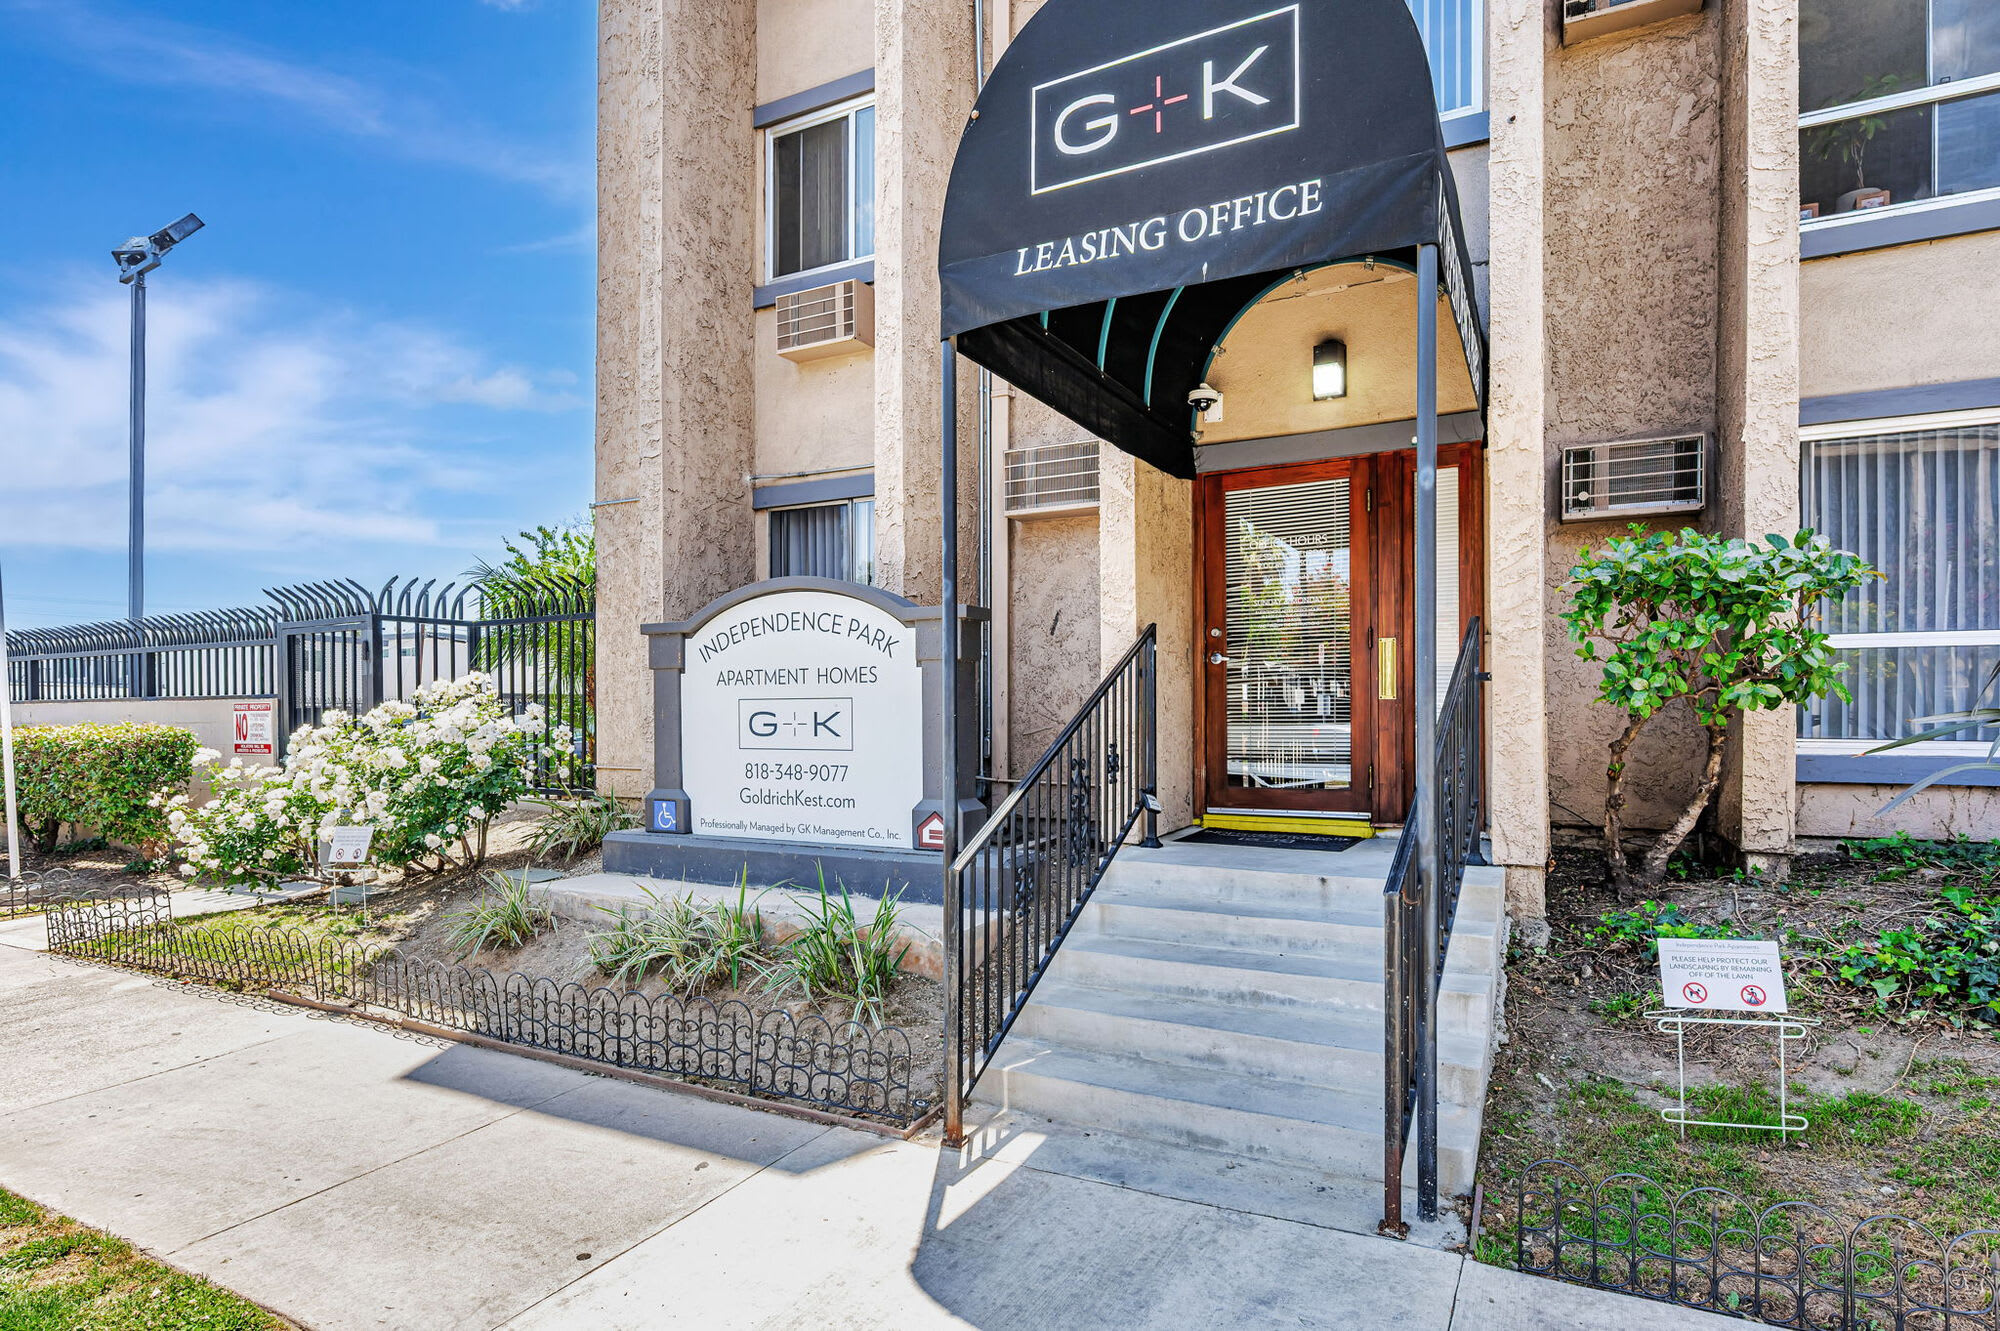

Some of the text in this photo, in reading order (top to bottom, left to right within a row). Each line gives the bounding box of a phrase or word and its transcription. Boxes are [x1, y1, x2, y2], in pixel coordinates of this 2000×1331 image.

[1013, 178, 1324, 276] LEASING OFFICE
[698, 611, 900, 663] INDEPENDENCE PARK
[716, 665, 878, 686] APARTMENT HOMES
[249, 703, 270, 711] PROPERTY
[235, 713, 248, 741] NO
[744, 763, 849, 782] 818-348-9077
[739, 787, 856, 808] GoldrichKest.com
[700, 817, 748, 832] Professionally
[749, 821, 785, 835] Managed
[786, 823, 796, 836] by
[797, 823, 812, 834] GK
[812, 824, 866, 838] Management
[887, 829, 901, 840] Inc.
[1669, 963, 1719, 971] LANDSCAPING
[1671, 955, 1697, 963] PLEASE
[1716, 957, 1749, 965] PROTECT
[1731, 972, 1754, 980] LAWN
